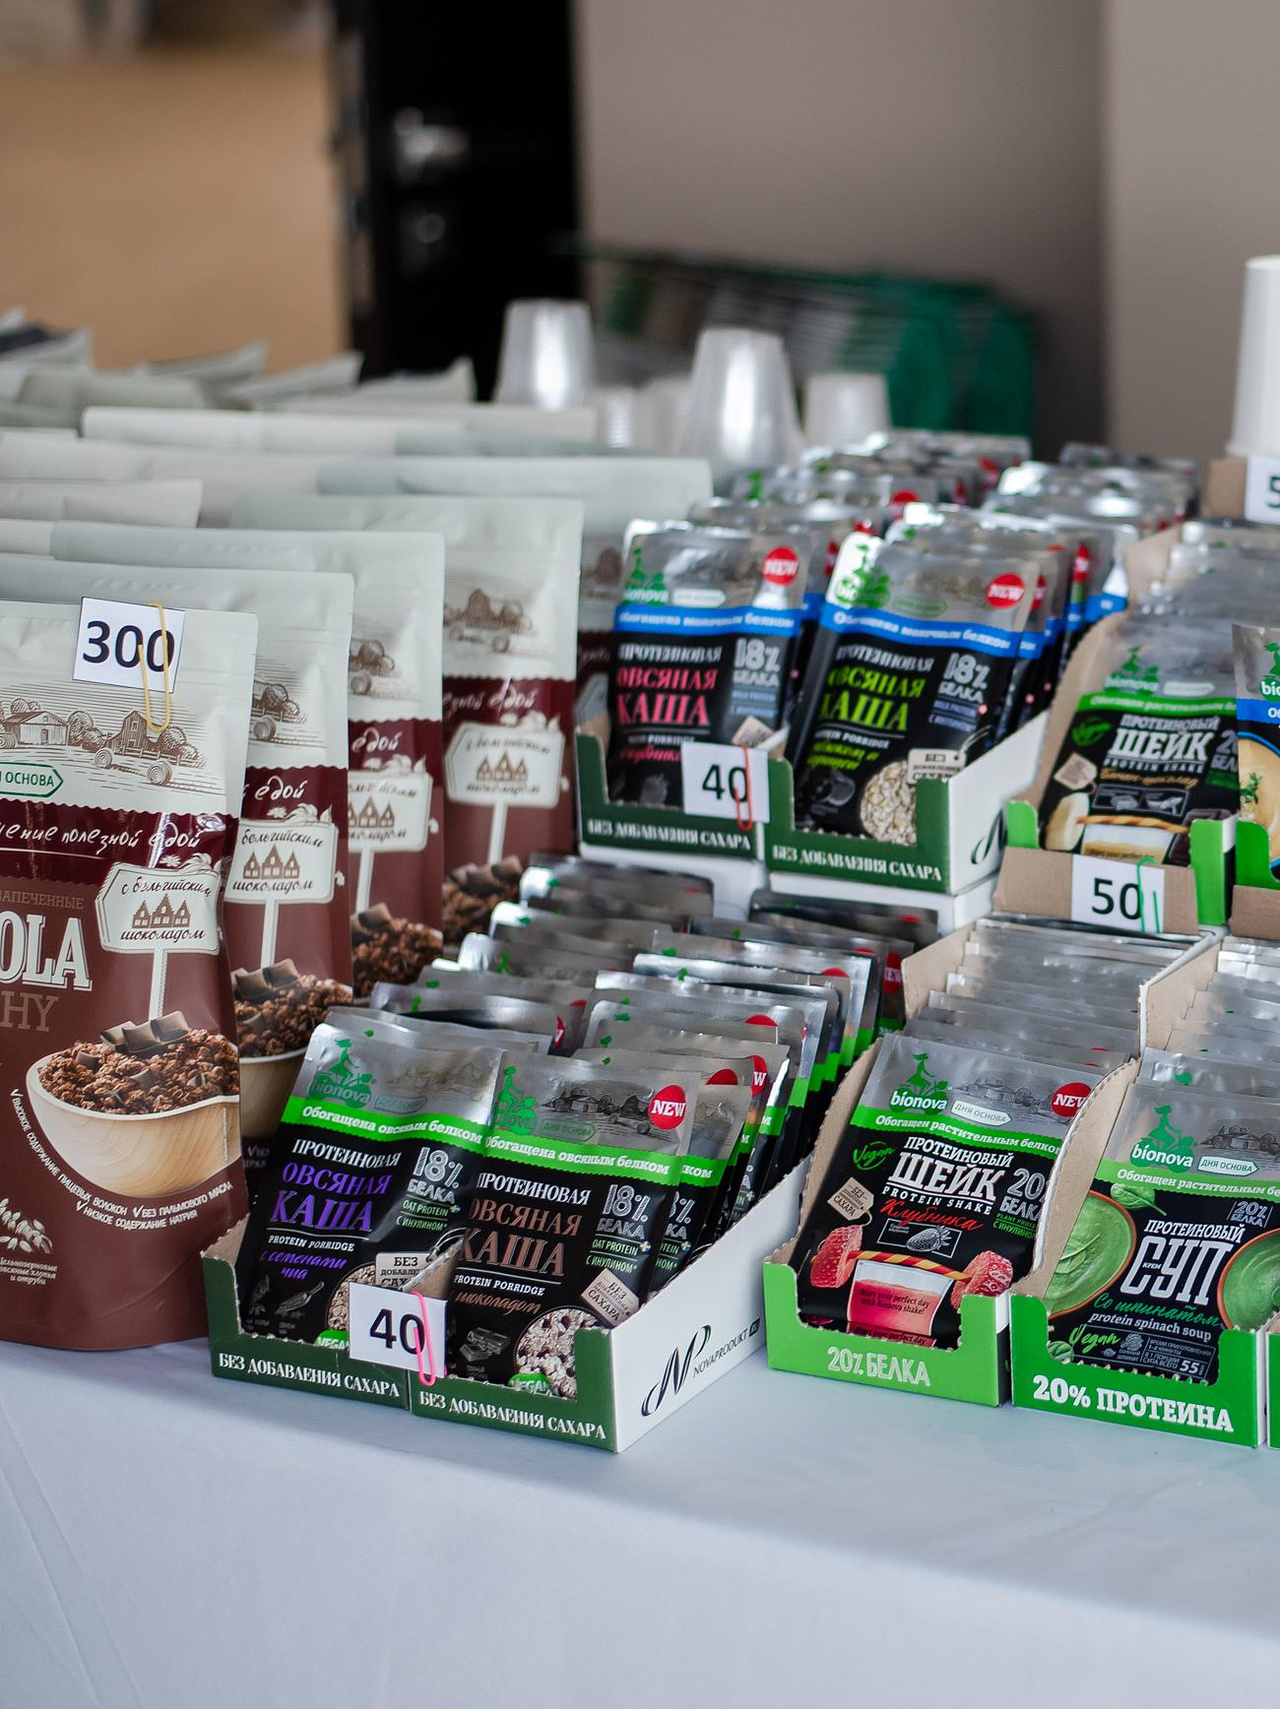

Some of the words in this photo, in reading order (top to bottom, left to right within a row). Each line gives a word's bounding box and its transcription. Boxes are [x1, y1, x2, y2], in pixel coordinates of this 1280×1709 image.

[82, 619, 175, 672] 300
[734, 637, 780, 673] 18%
[943, 652, 991, 689] 18%
[617, 692, 710, 727] КАША
[1120, 713, 1221, 731] ПРОТЕИНОВЫЙ
[4, 772, 55, 788] ОСНОВА
[255, 775, 309, 801] едой
[702, 763, 749, 804] 40
[586, 818, 613, 836] БЕЗ
[615, 822, 699, 844] ДОБАВЛЕНИЯ
[701, 826, 751, 851] САХАРА
[772, 845, 798, 862] БЕЗ
[801, 848, 886, 874] ДОБАВЛЕНИЯ
[888, 857, 942, 882] САХАРА
[1091, 878, 1141, 920] 50
[120, 927, 206, 943] шоколадом
[649, 1099, 686, 1119] NEW
[890, 1090, 948, 1111] bionova
[954, 1103, 972, 1115] ДНЯ
[973, 1107, 1008, 1124] ОСНОВА
[292, 1138, 402, 1170] ПРОТЕИНОВАЯ
[413, 1146, 464, 1190] 18%
[904, 1136, 1015, 1169] ПРОТЕИНОВЫЙ
[1131, 1144, 1194, 1168] bionova
[1200, 1159, 1218, 1169] ДНЯ
[1219, 1160, 1254, 1173] ОСНОВА
[282, 1161, 393, 1197] ОВСЯНАЯ
[407, 1178, 456, 1205] БЕЛКА
[477, 1172, 591, 1206] ПРОТЕИНОВАЯ
[269, 1189, 374, 1233] КАША
[402, 1199, 419, 1211] OAT
[419, 1202, 449, 1217] PROTEIN
[602, 1183, 651, 1224] 18%
[881, 1185, 942, 1208] PROTEIN
[946, 1196, 993, 1217] SHAKE
[595, 1216, 646, 1241] БЕЛКА
[1144, 1218, 1245, 1245] ПРОТЕИНОВЫЙ
[1230, 1213, 1265, 1228] БЕЛКА
[268, 1235, 307, 1248] PROTEIN
[309, 1239, 356, 1252] PORRIDGE
[461, 1227, 565, 1277] КАША
[591, 1239, 607, 1251] OAT
[607, 1241, 639, 1258] PROTEIN
[393, 1256, 419, 1267] БЕЗ
[1120, 1235, 1235, 1306] СУП
[453, 1274, 491, 1287] PROTEIN
[493, 1278, 546, 1298] PORRIDGE
[608, 1280, 628, 1301] БЕЗ
[369, 1308, 425, 1356] 40
[1088, 1312, 1133, 1326] protein
[1133, 1318, 1181, 1335] spinach
[1182, 1326, 1213, 1343] soup
[218, 1352, 246, 1372] БЕЗ
[247, 1357, 341, 1388] ДОБАВЛЕНИЯ
[343, 1377, 401, 1398] САХАРА
[828, 1346, 865, 1378] 20%
[866, 1352, 931, 1387] БЕЛКА
[419, 1391, 446, 1410] БЕЗ
[449, 1398, 545, 1430] ДОБАВЛЕНИЯ
[547, 1415, 607, 1441] САХАРА
[1033, 1373, 1092, 1409] 20%
[1096, 1386, 1235, 1434] ПРОТЕИНА
